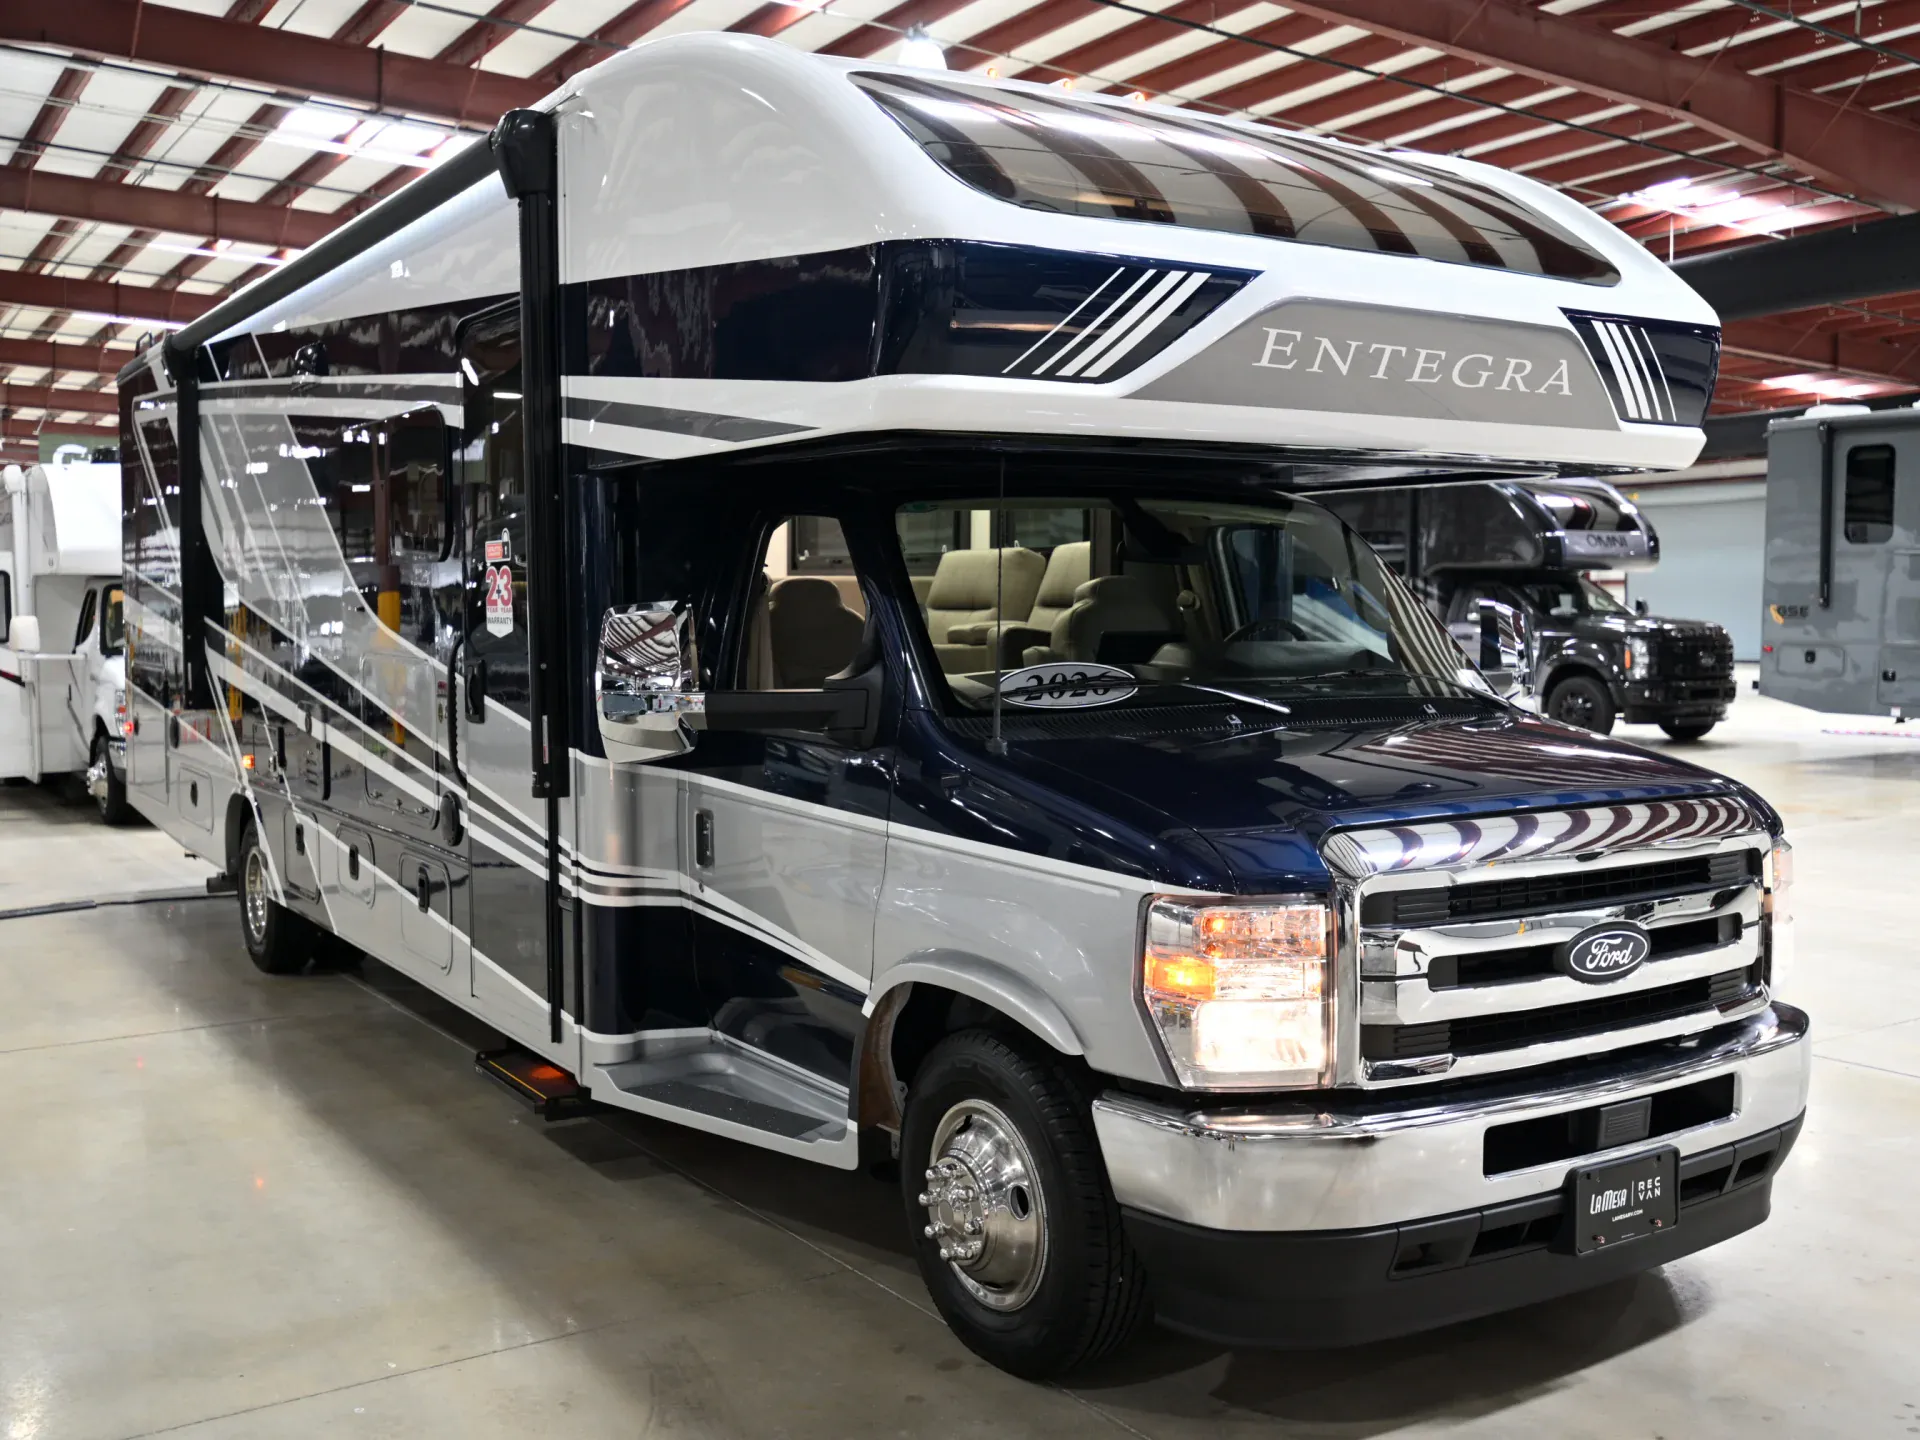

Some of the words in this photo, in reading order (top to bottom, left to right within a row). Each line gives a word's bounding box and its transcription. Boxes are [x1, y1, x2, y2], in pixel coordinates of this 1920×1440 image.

[1252, 327, 1573, 396] ENTEGRA
[1586, 533, 1629, 548] OMNI
[487, 616, 512, 625] WARRANTY
[1586, 938, 1633, 969] Ford
[1638, 1176, 1661, 1191] REC
[1638, 1187, 1661, 1201] VAN
